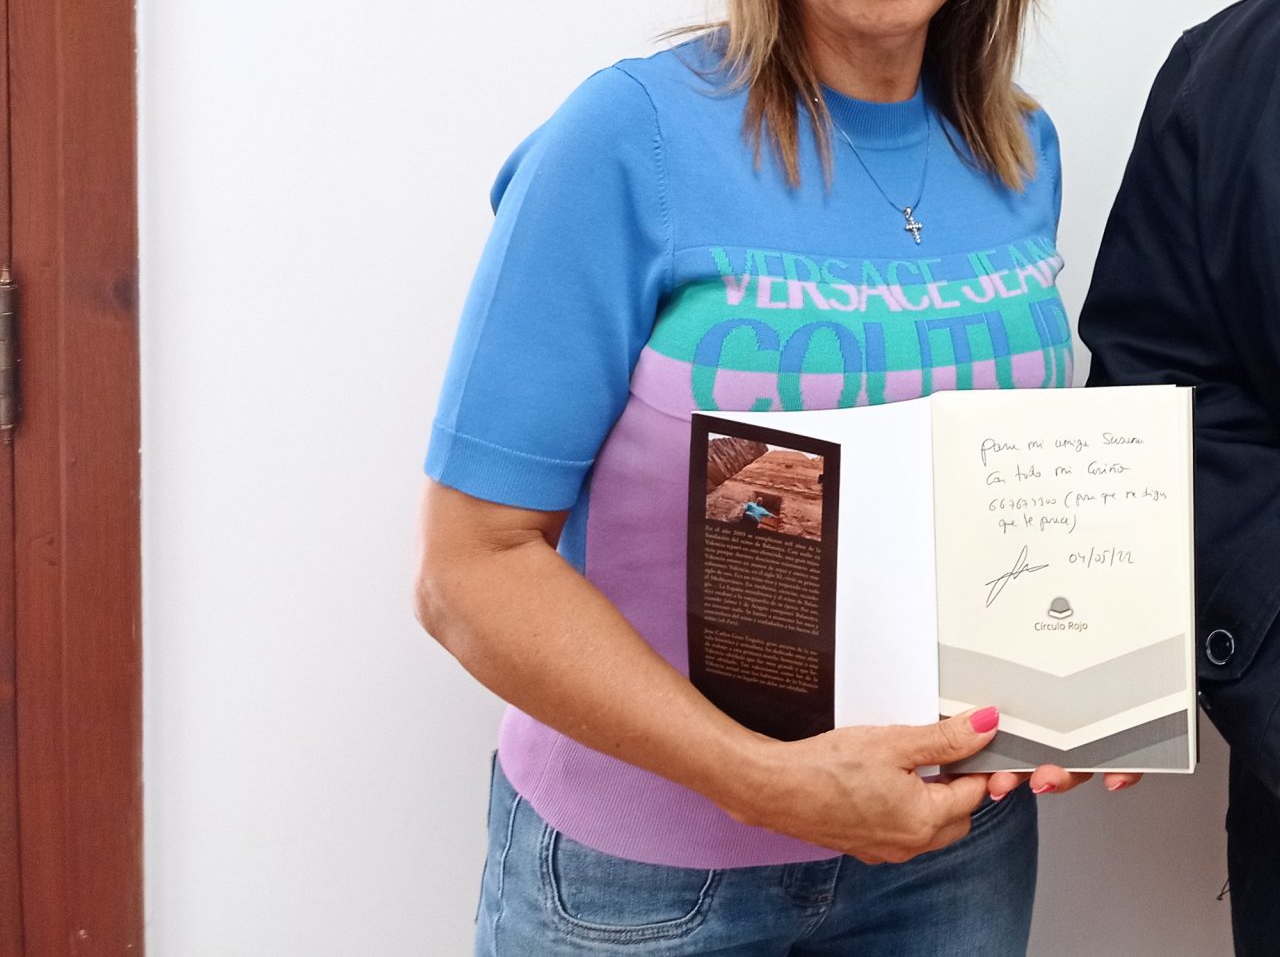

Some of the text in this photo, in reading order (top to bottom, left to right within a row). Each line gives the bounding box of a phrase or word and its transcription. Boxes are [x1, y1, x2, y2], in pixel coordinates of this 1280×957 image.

[711, 246, 960, 312] VERSACE
[1028, 439, 1043, 450] mi
[1055, 466, 1072, 477] mi
[1067, 621, 1089, 632] Rojo
